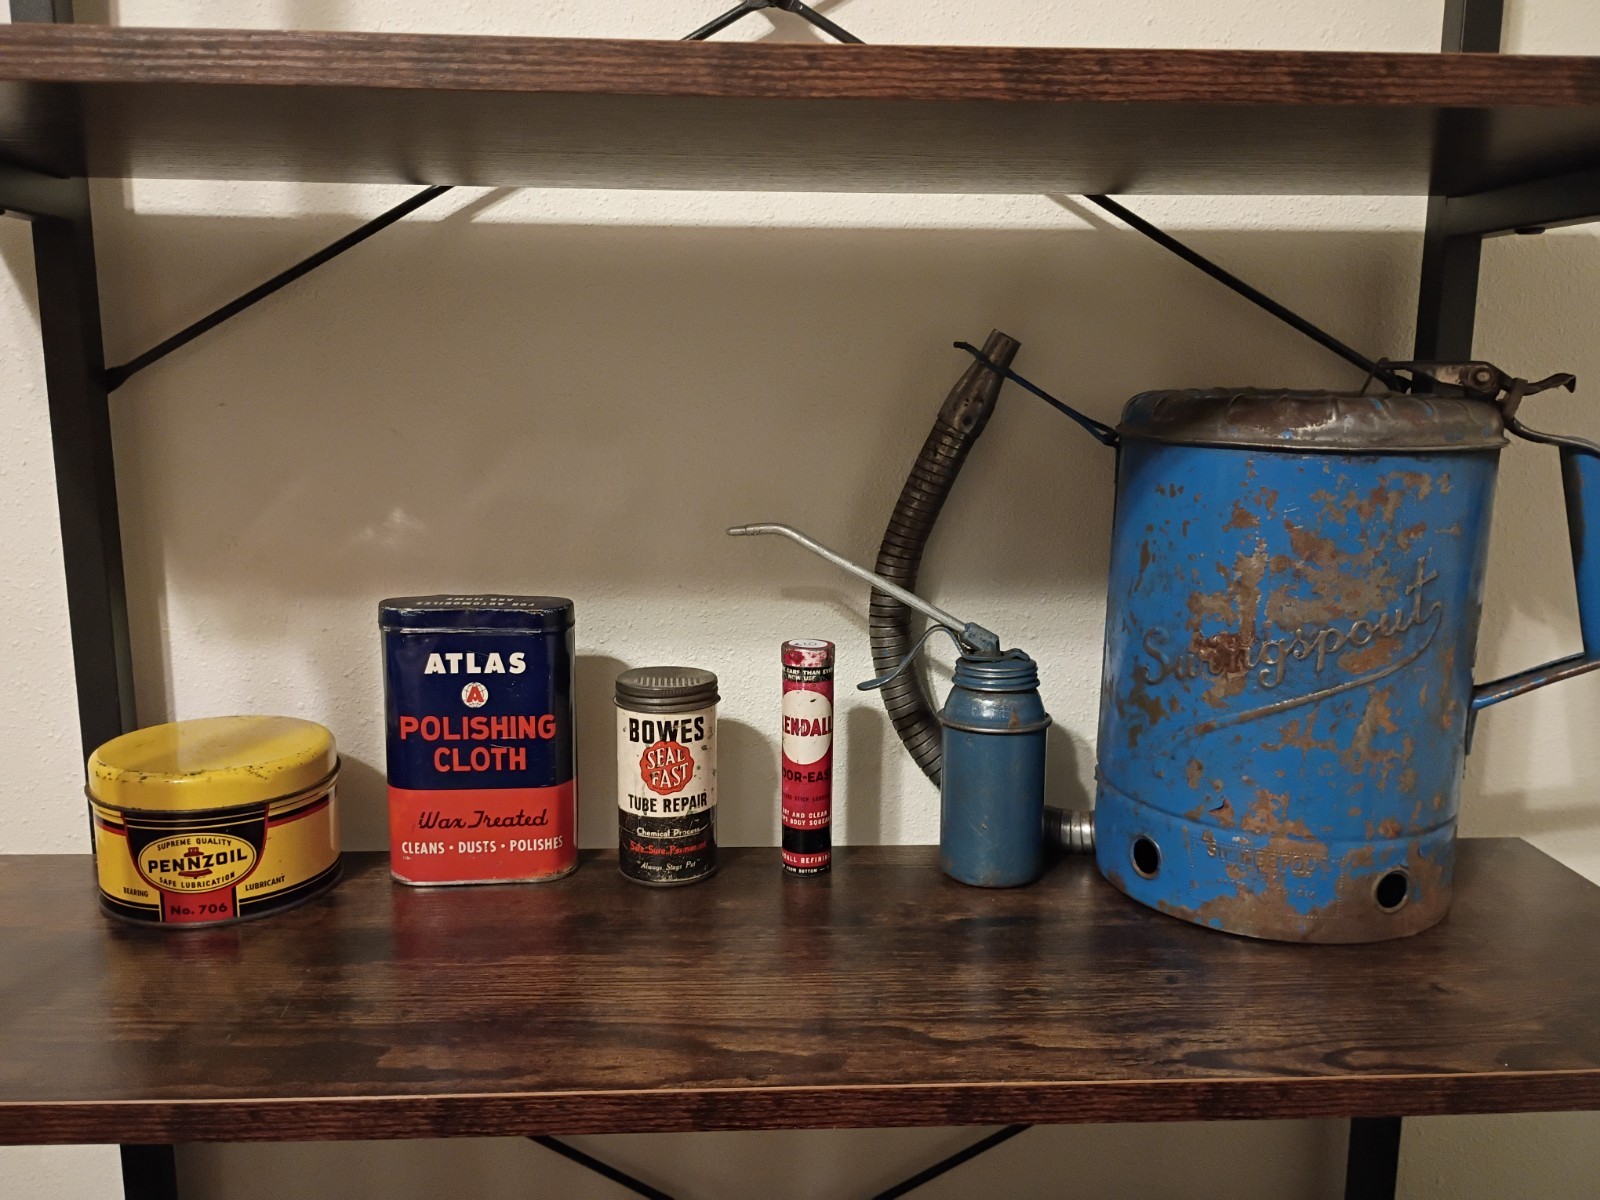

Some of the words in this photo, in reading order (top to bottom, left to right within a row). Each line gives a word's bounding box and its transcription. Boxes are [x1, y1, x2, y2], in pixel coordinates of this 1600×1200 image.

[424, 652, 527, 674] ATLAS
[466, 685, 485, 703] A
[400, 713, 557, 741] POLISHING
[628, 716, 704, 744] BOWES
[782, 715, 832, 737] ENDALL
[433, 746, 527, 773] CLOTH
[647, 746, 686, 770] SEAL
[650, 762, 689, 788] FAST
[628, 793, 657, 813] TUBE
[663, 792, 708, 813] REPAIR
[418, 811, 467, 829] Wax
[467, 809, 549, 829] Treated
[790, 818, 806, 826] BODY
[792, 811, 806, 819] AND
[808, 810, 828, 819] CLEAN
[636, 827, 671, 837] Chemical
[673, 827, 701, 837] Process
[157, 838, 191, 851] SUPREME
[196, 837, 232, 847] QUALITY
[401, 841, 445, 855] CLEANS
[458, 840, 497, 854] DUSTS
[509, 836, 563, 852] POLISHES
[148, 848, 248, 873] PENNZOIL
[159, 877, 177, 887] SAFE
[181, 871, 235, 888] LUBRICATION
[245, 875, 286, 891] LUBRICANT
[123, 886, 149, 898] BEARING
[170, 905, 195, 915] No.
[198, 903, 228, 915] 706
